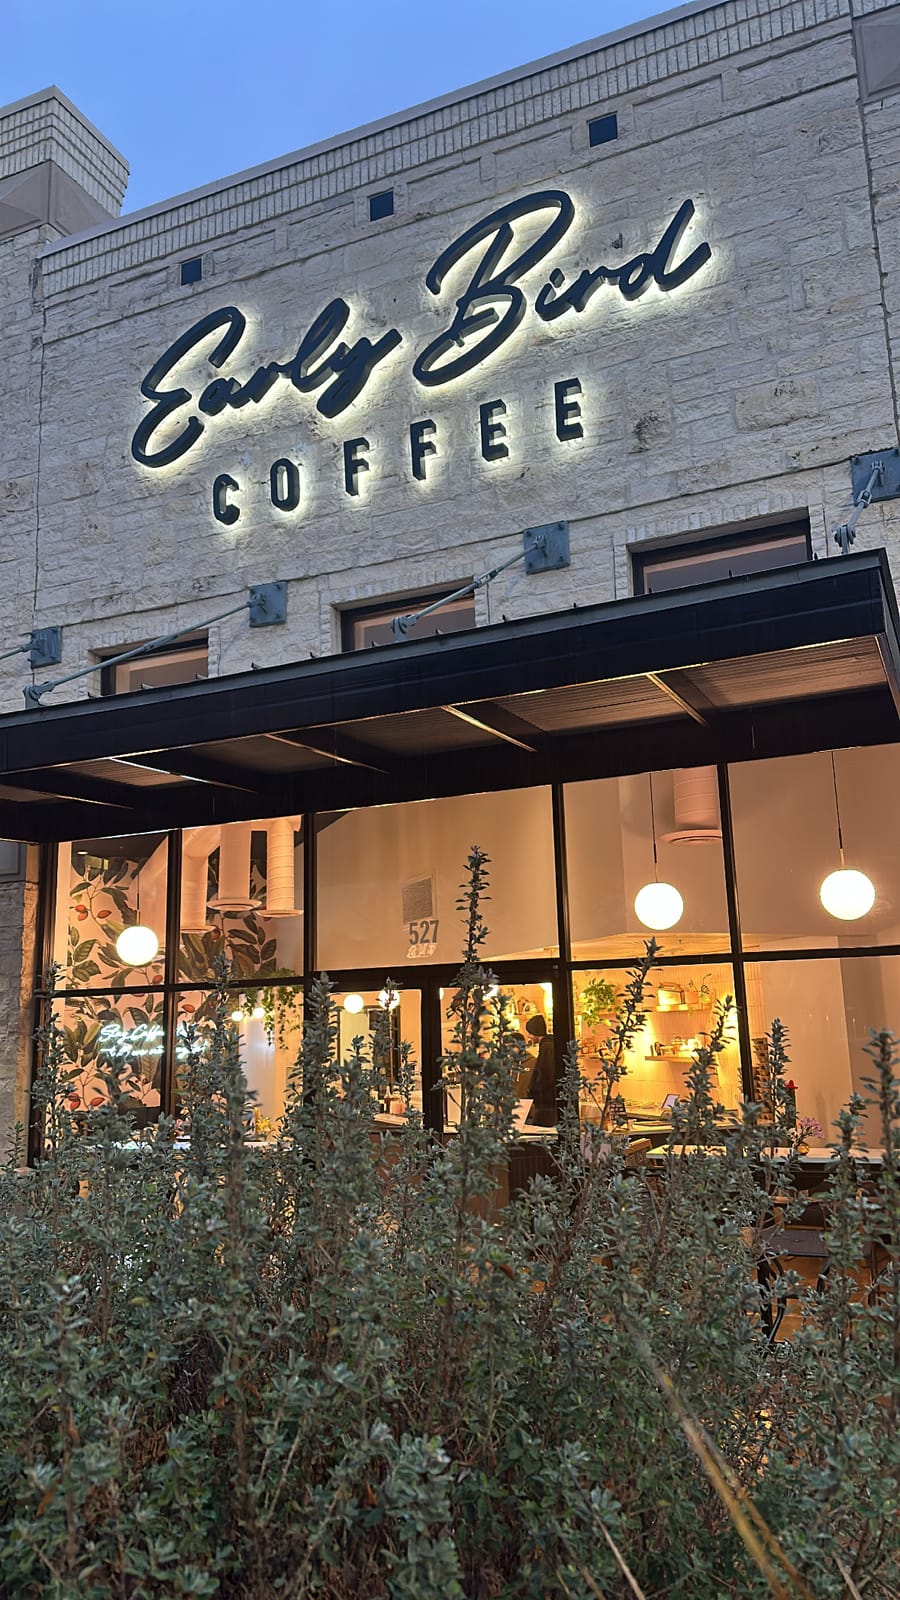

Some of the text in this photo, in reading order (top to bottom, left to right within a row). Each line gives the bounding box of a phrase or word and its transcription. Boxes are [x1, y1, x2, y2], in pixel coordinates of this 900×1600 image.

[131, 190, 712, 468] Early Bird
[212, 377, 584, 526] COFFEE
[409, 919, 439, 945] 527
